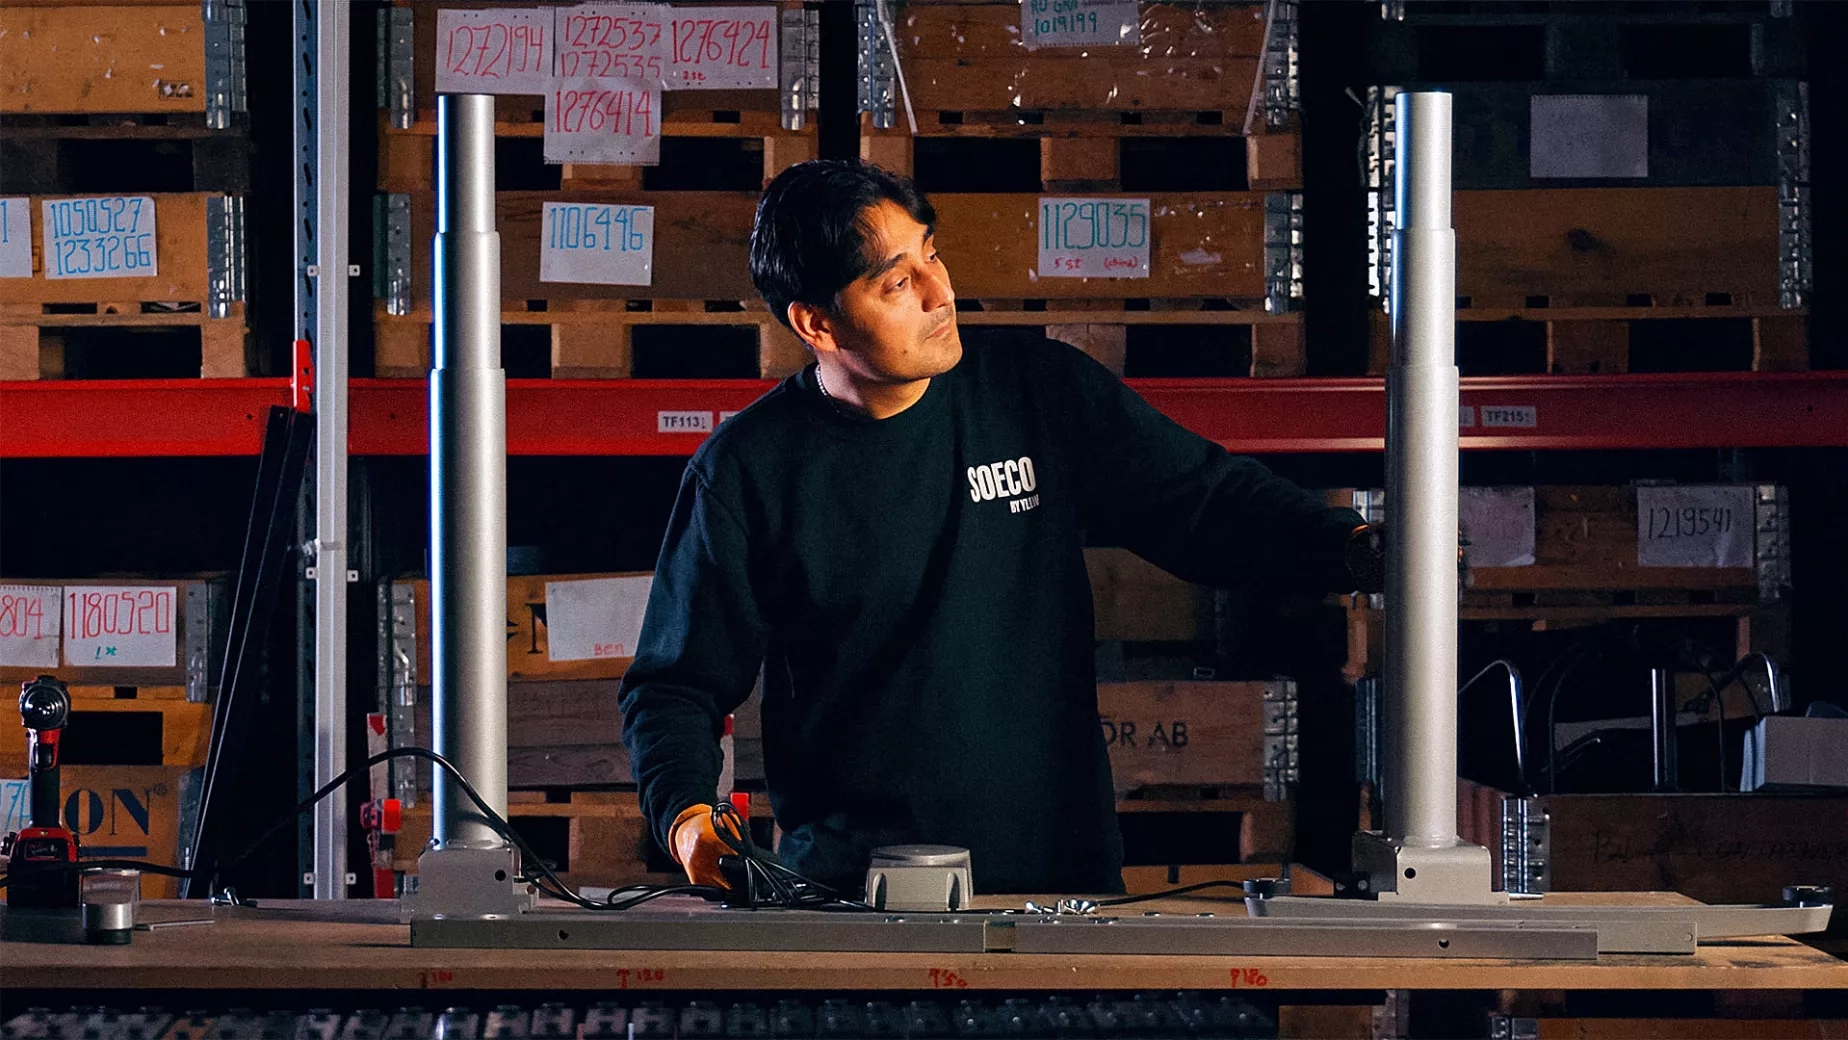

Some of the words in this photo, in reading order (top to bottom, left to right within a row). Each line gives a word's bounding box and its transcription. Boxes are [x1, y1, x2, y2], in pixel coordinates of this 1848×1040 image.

[446, 23, 544, 78] 1272194
[565, 16, 661, 50] 1272537
[671, 19, 772, 69] 1276424
[556, 90, 653, 137] 1276414
[51, 197, 143, 239] 1050527
[550, 206, 648, 252] 1106446
[1044, 202, 1146, 249] 1129035
[55, 233, 151, 276] 1233266
[967, 456, 1037, 503] SOECO
[1009, 500, 1021, 514] BY
[1648, 507, 1731, 540] 1219541
[70, 591, 170, 640] 1180520
[1147, 721, 1189, 749] AB
